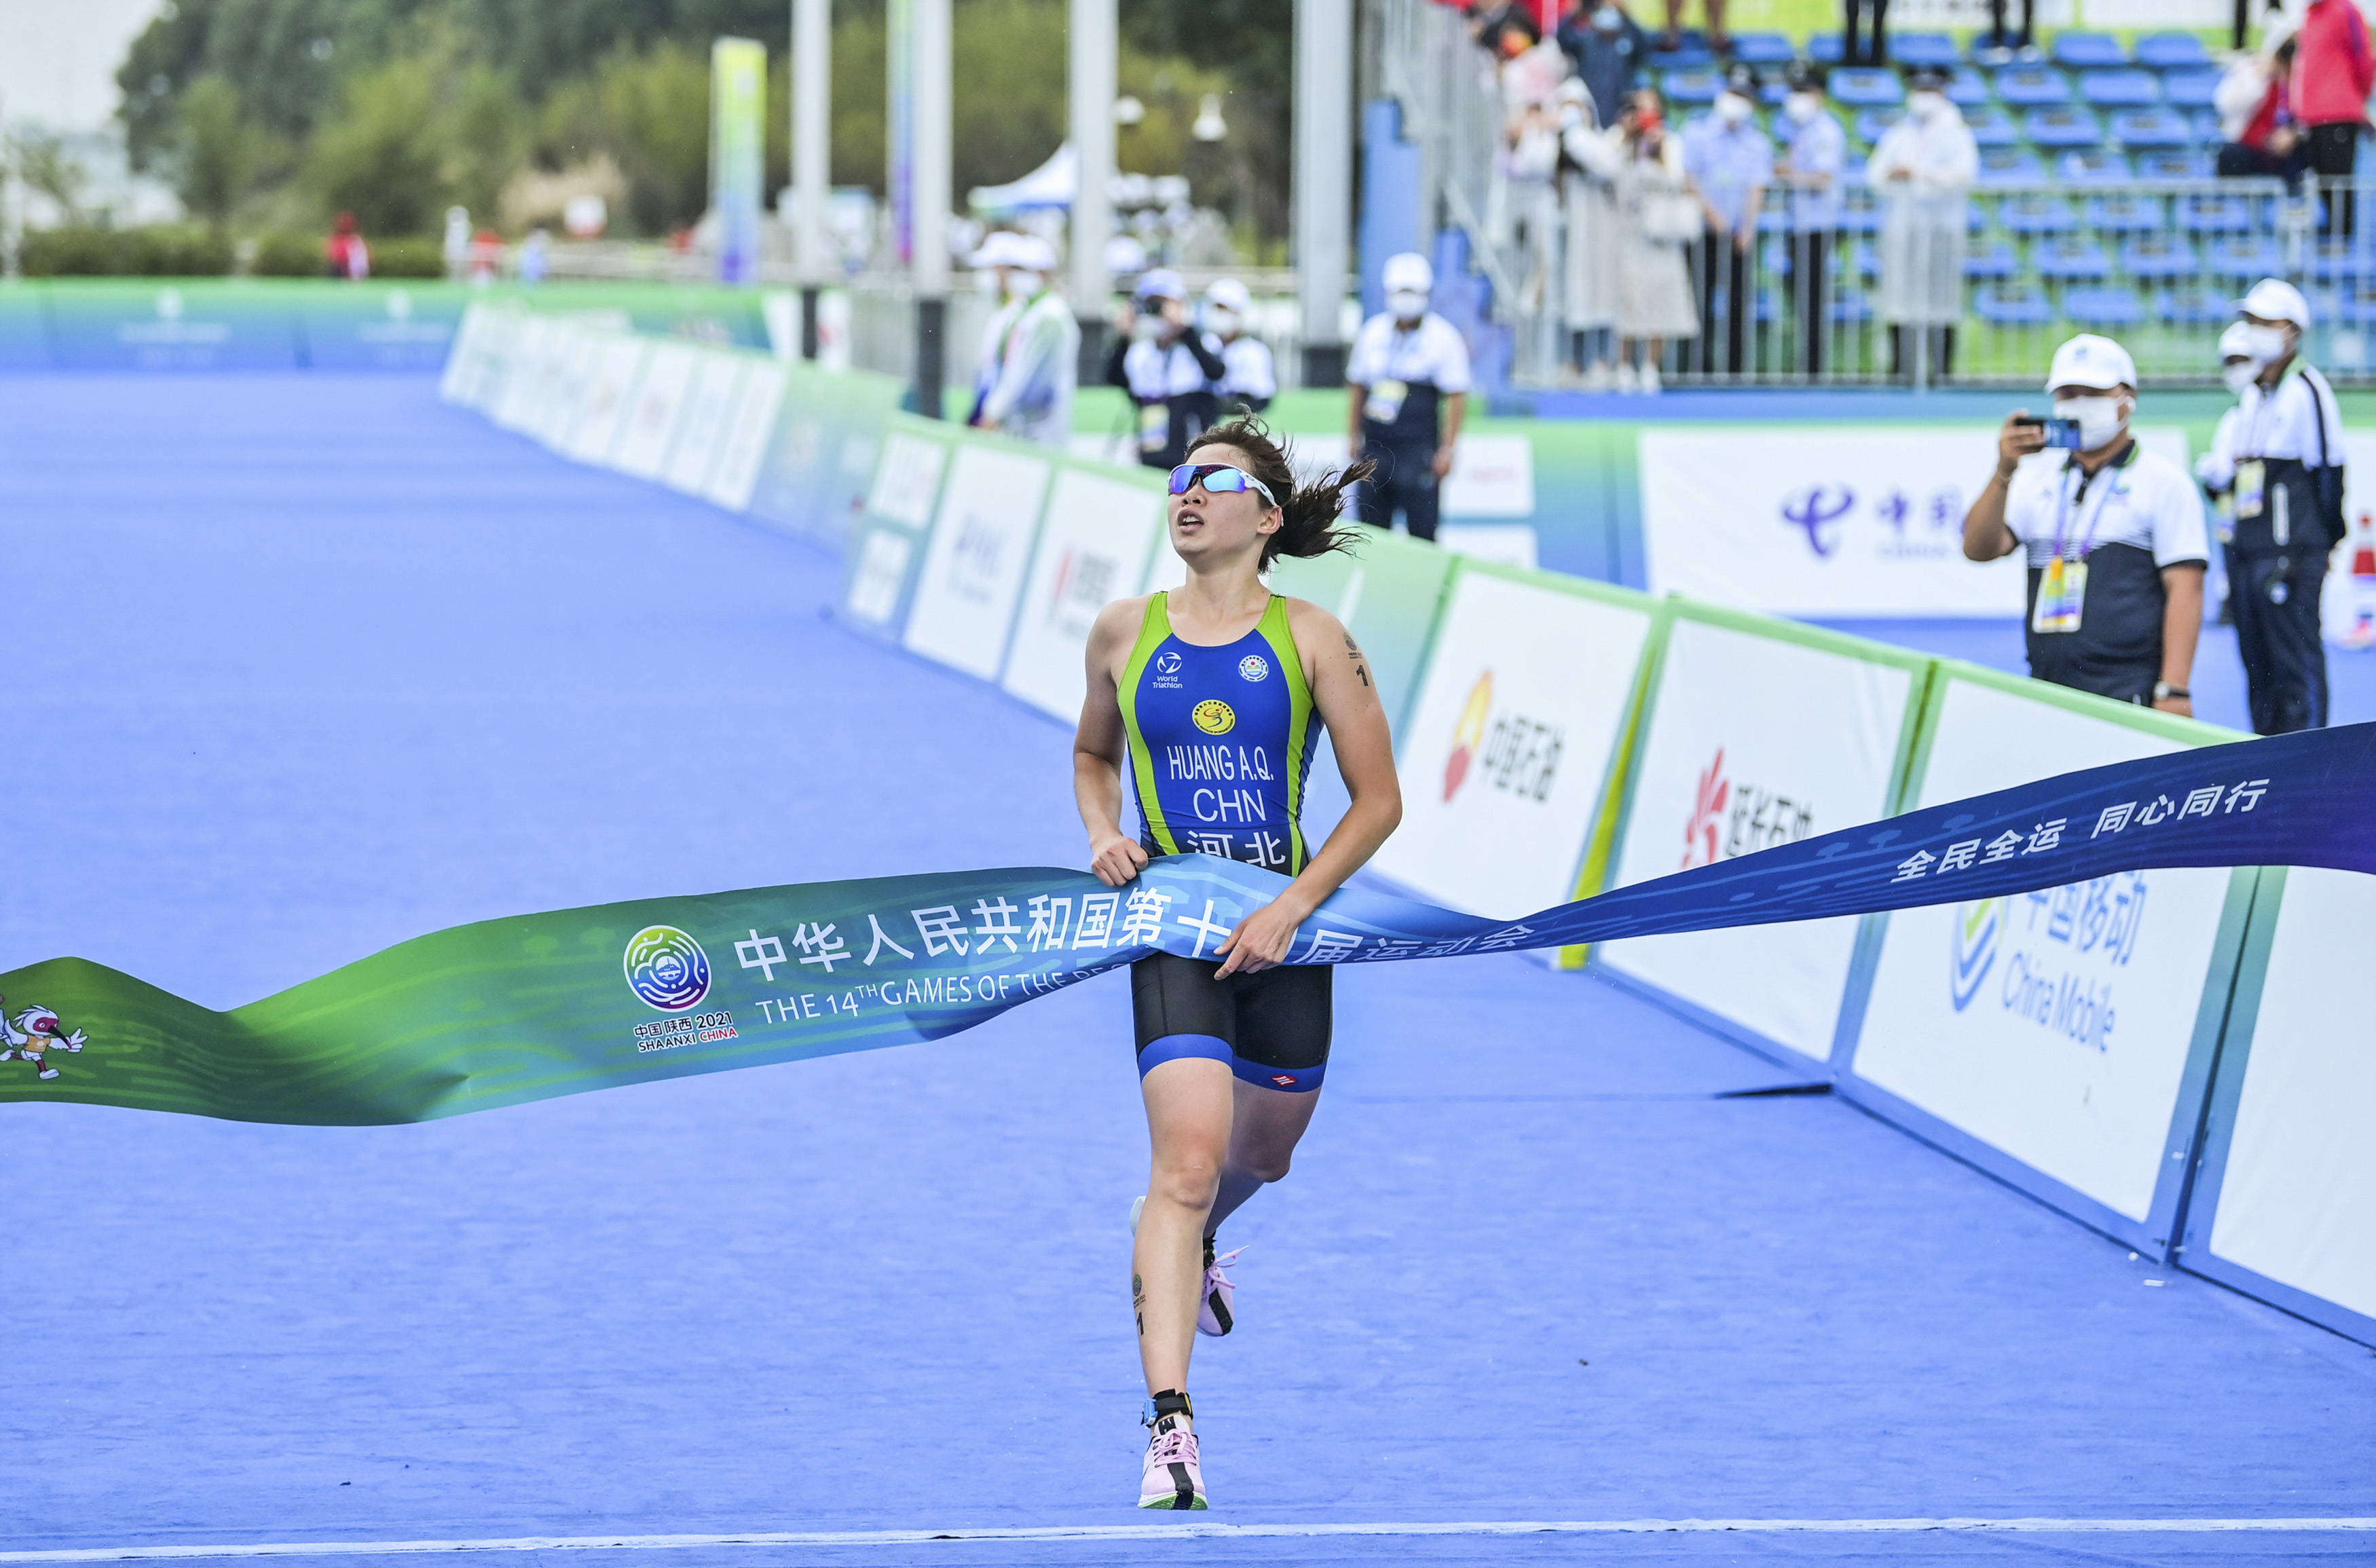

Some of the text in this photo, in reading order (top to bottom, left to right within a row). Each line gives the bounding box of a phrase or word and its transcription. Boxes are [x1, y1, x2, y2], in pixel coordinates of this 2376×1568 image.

[1356, 665, 1369, 686] 1
[1167, 745, 1274, 781] HUANG A.Q.
[1193, 788, 1267, 823] CHN
[1187, 830, 1286, 867] 河北
[1891, 779, 2270, 883] 全民全运 同心同行
[734, 886, 1536, 982] 中华人民共和国第十届运动会
[755, 993, 821, 1024] THE
[880, 975, 972, 1005] GAMES
[978, 974, 1010, 1001] OF
[1015, 972, 1066, 996] THE
[2003, 950, 2116, 1053] China Mobile
[635, 1011, 734, 1039] 中国 陕西 2021
[638, 1027, 739, 1053] SHAANXI CHINA
[1136, 1311, 1145, 1336] 1
